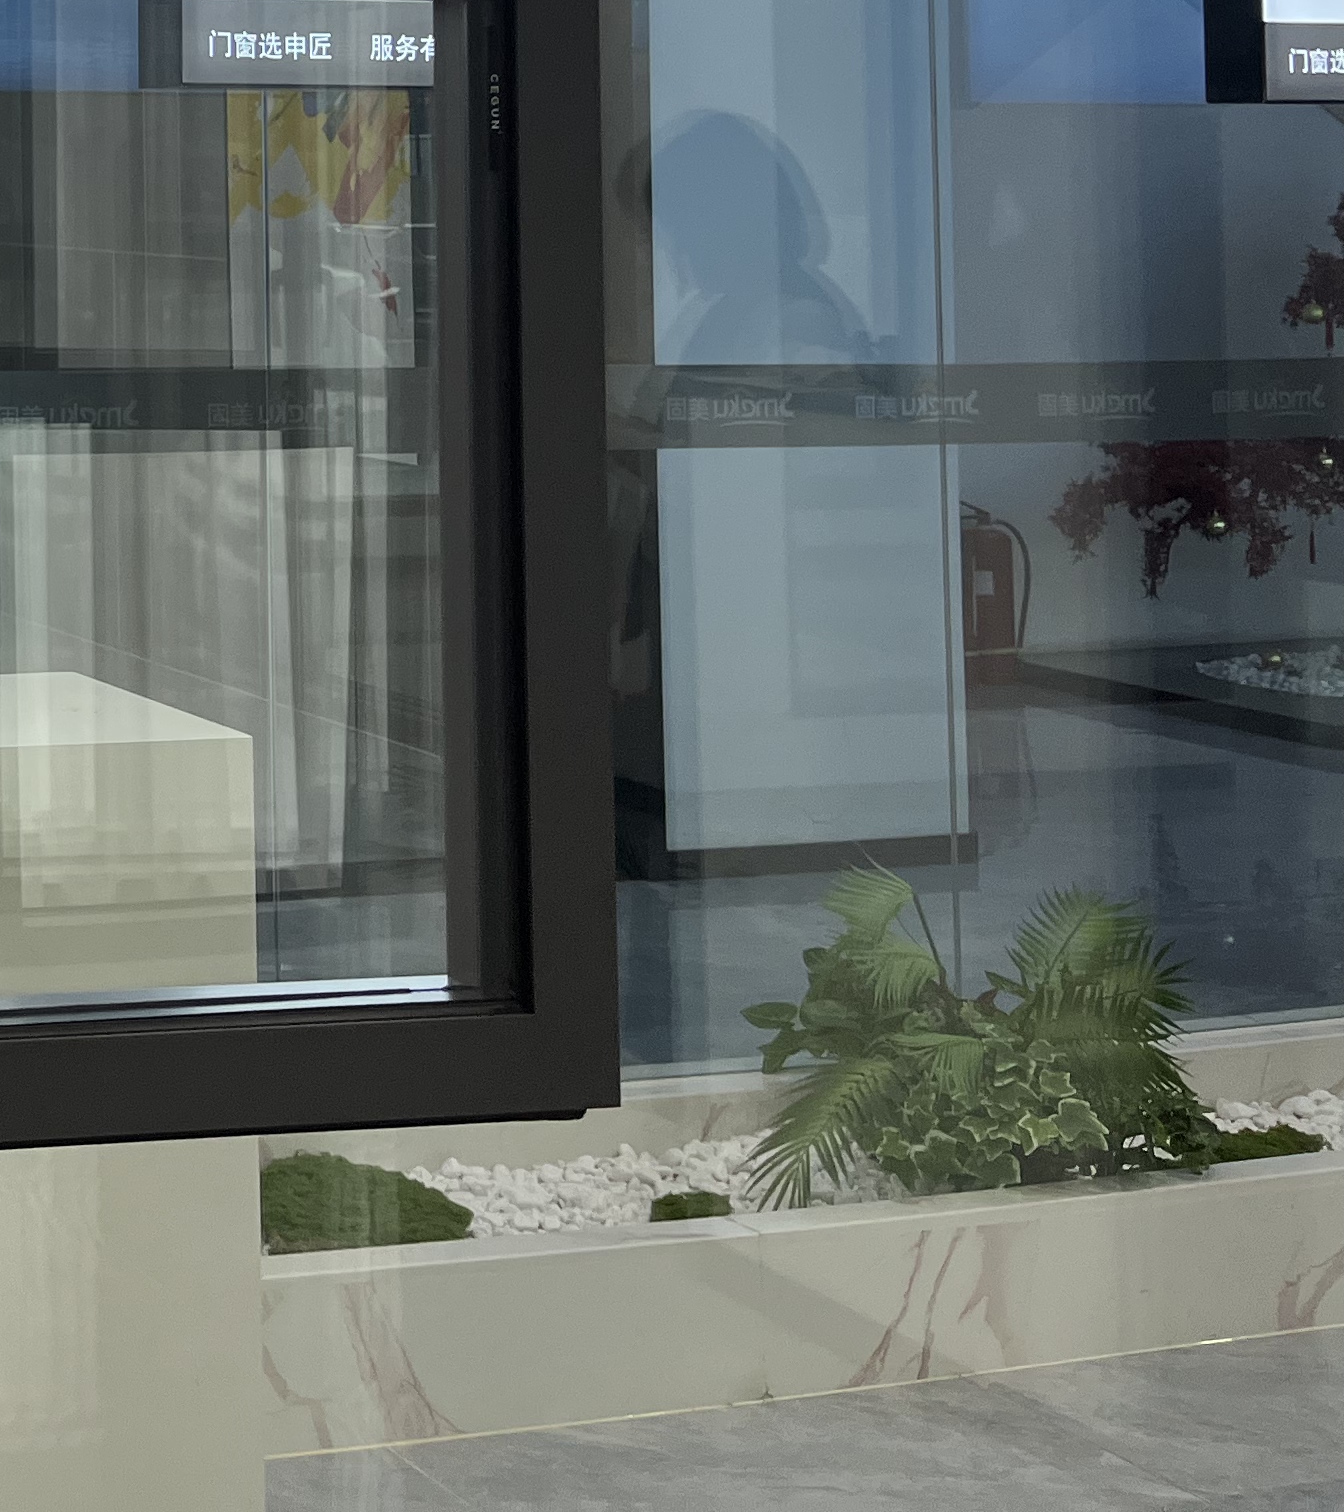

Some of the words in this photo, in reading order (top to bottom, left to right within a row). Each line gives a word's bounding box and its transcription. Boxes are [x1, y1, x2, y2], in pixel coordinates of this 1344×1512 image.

[209, 30, 332, 60] 门窗选申匠
